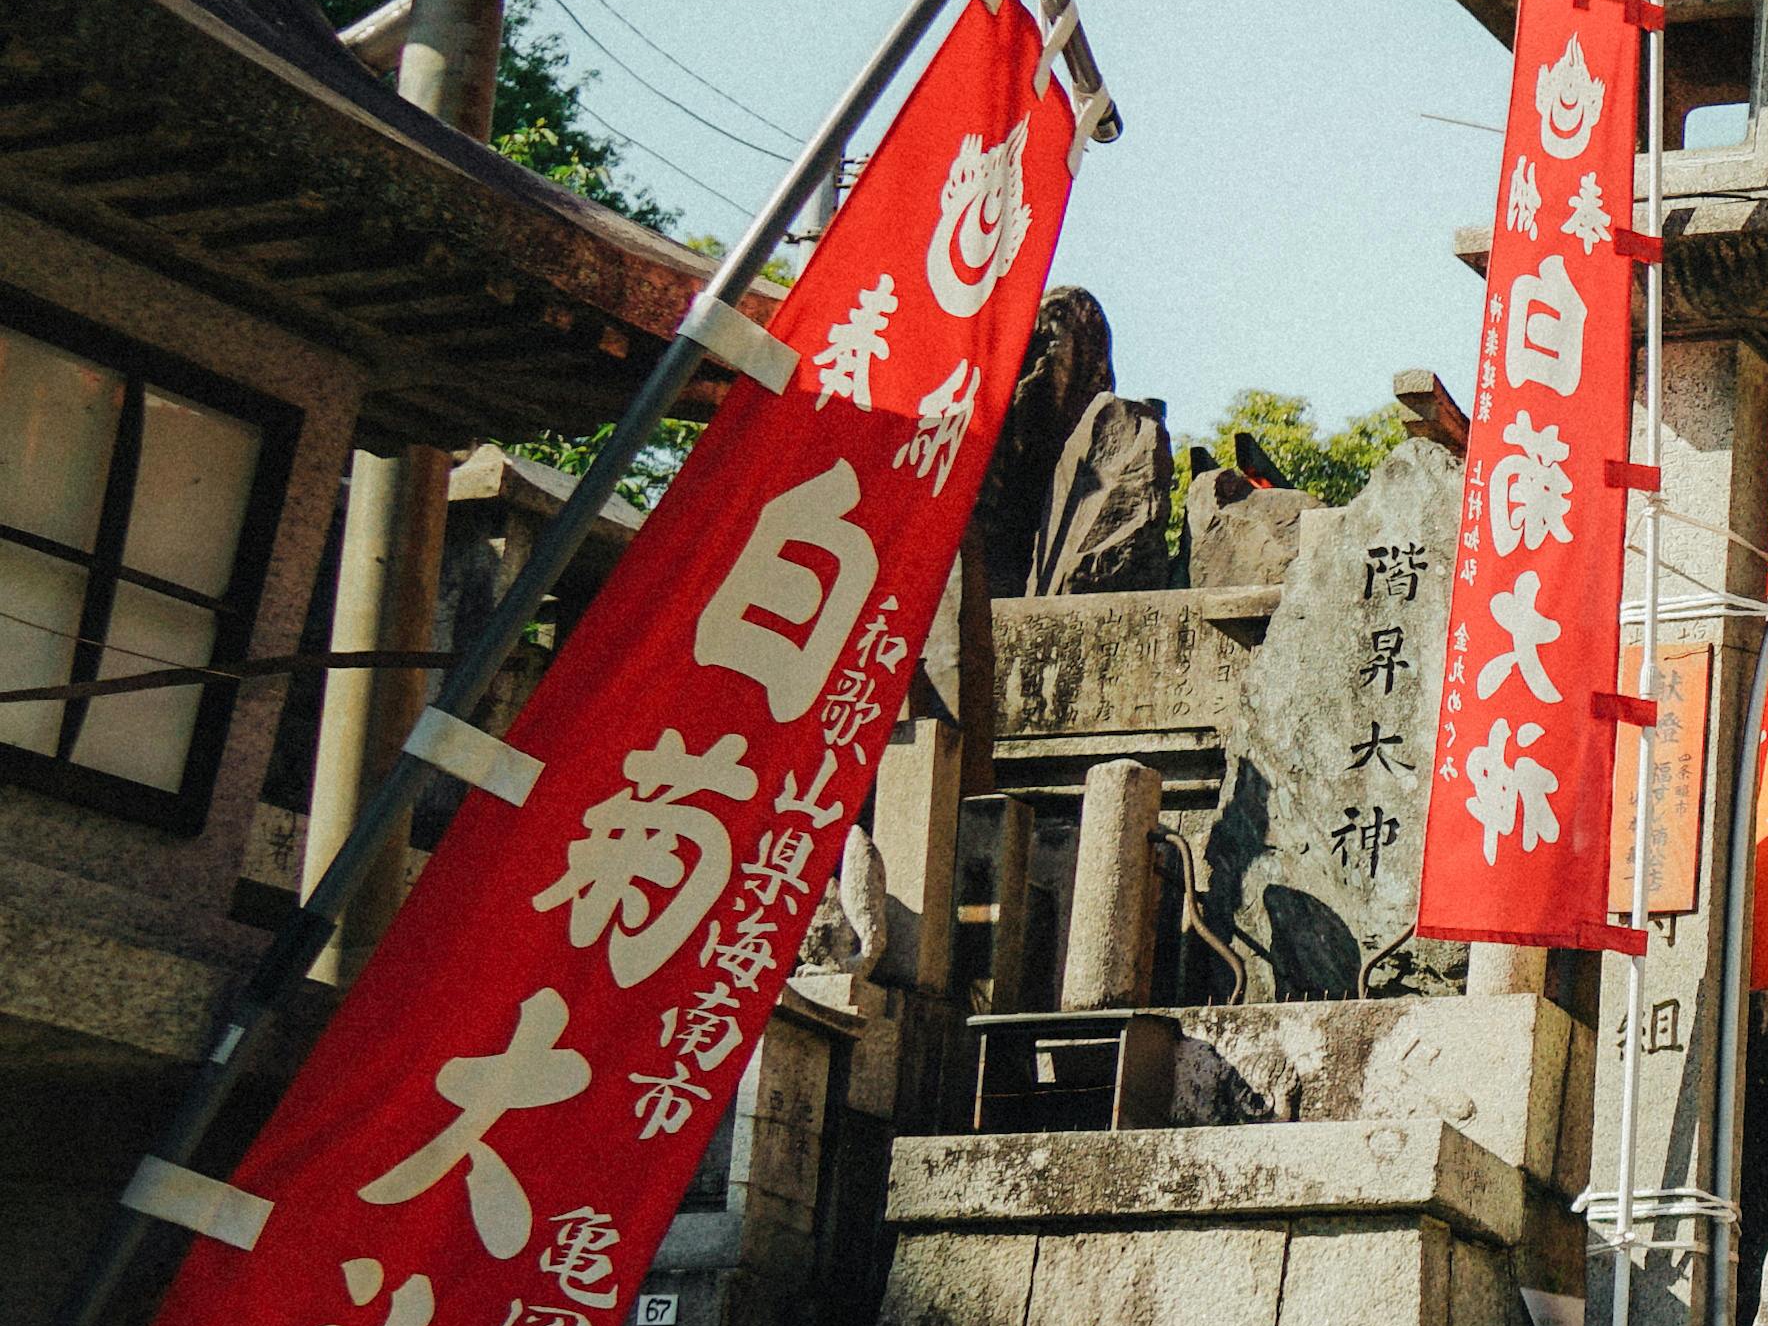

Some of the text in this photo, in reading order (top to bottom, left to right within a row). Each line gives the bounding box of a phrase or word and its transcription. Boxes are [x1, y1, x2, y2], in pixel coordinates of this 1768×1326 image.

[815, 274, 980, 496] 奉納
[635, 596, 908, 1137] 和歌山県海南市
[645, 1298, 672, 1323] 67
